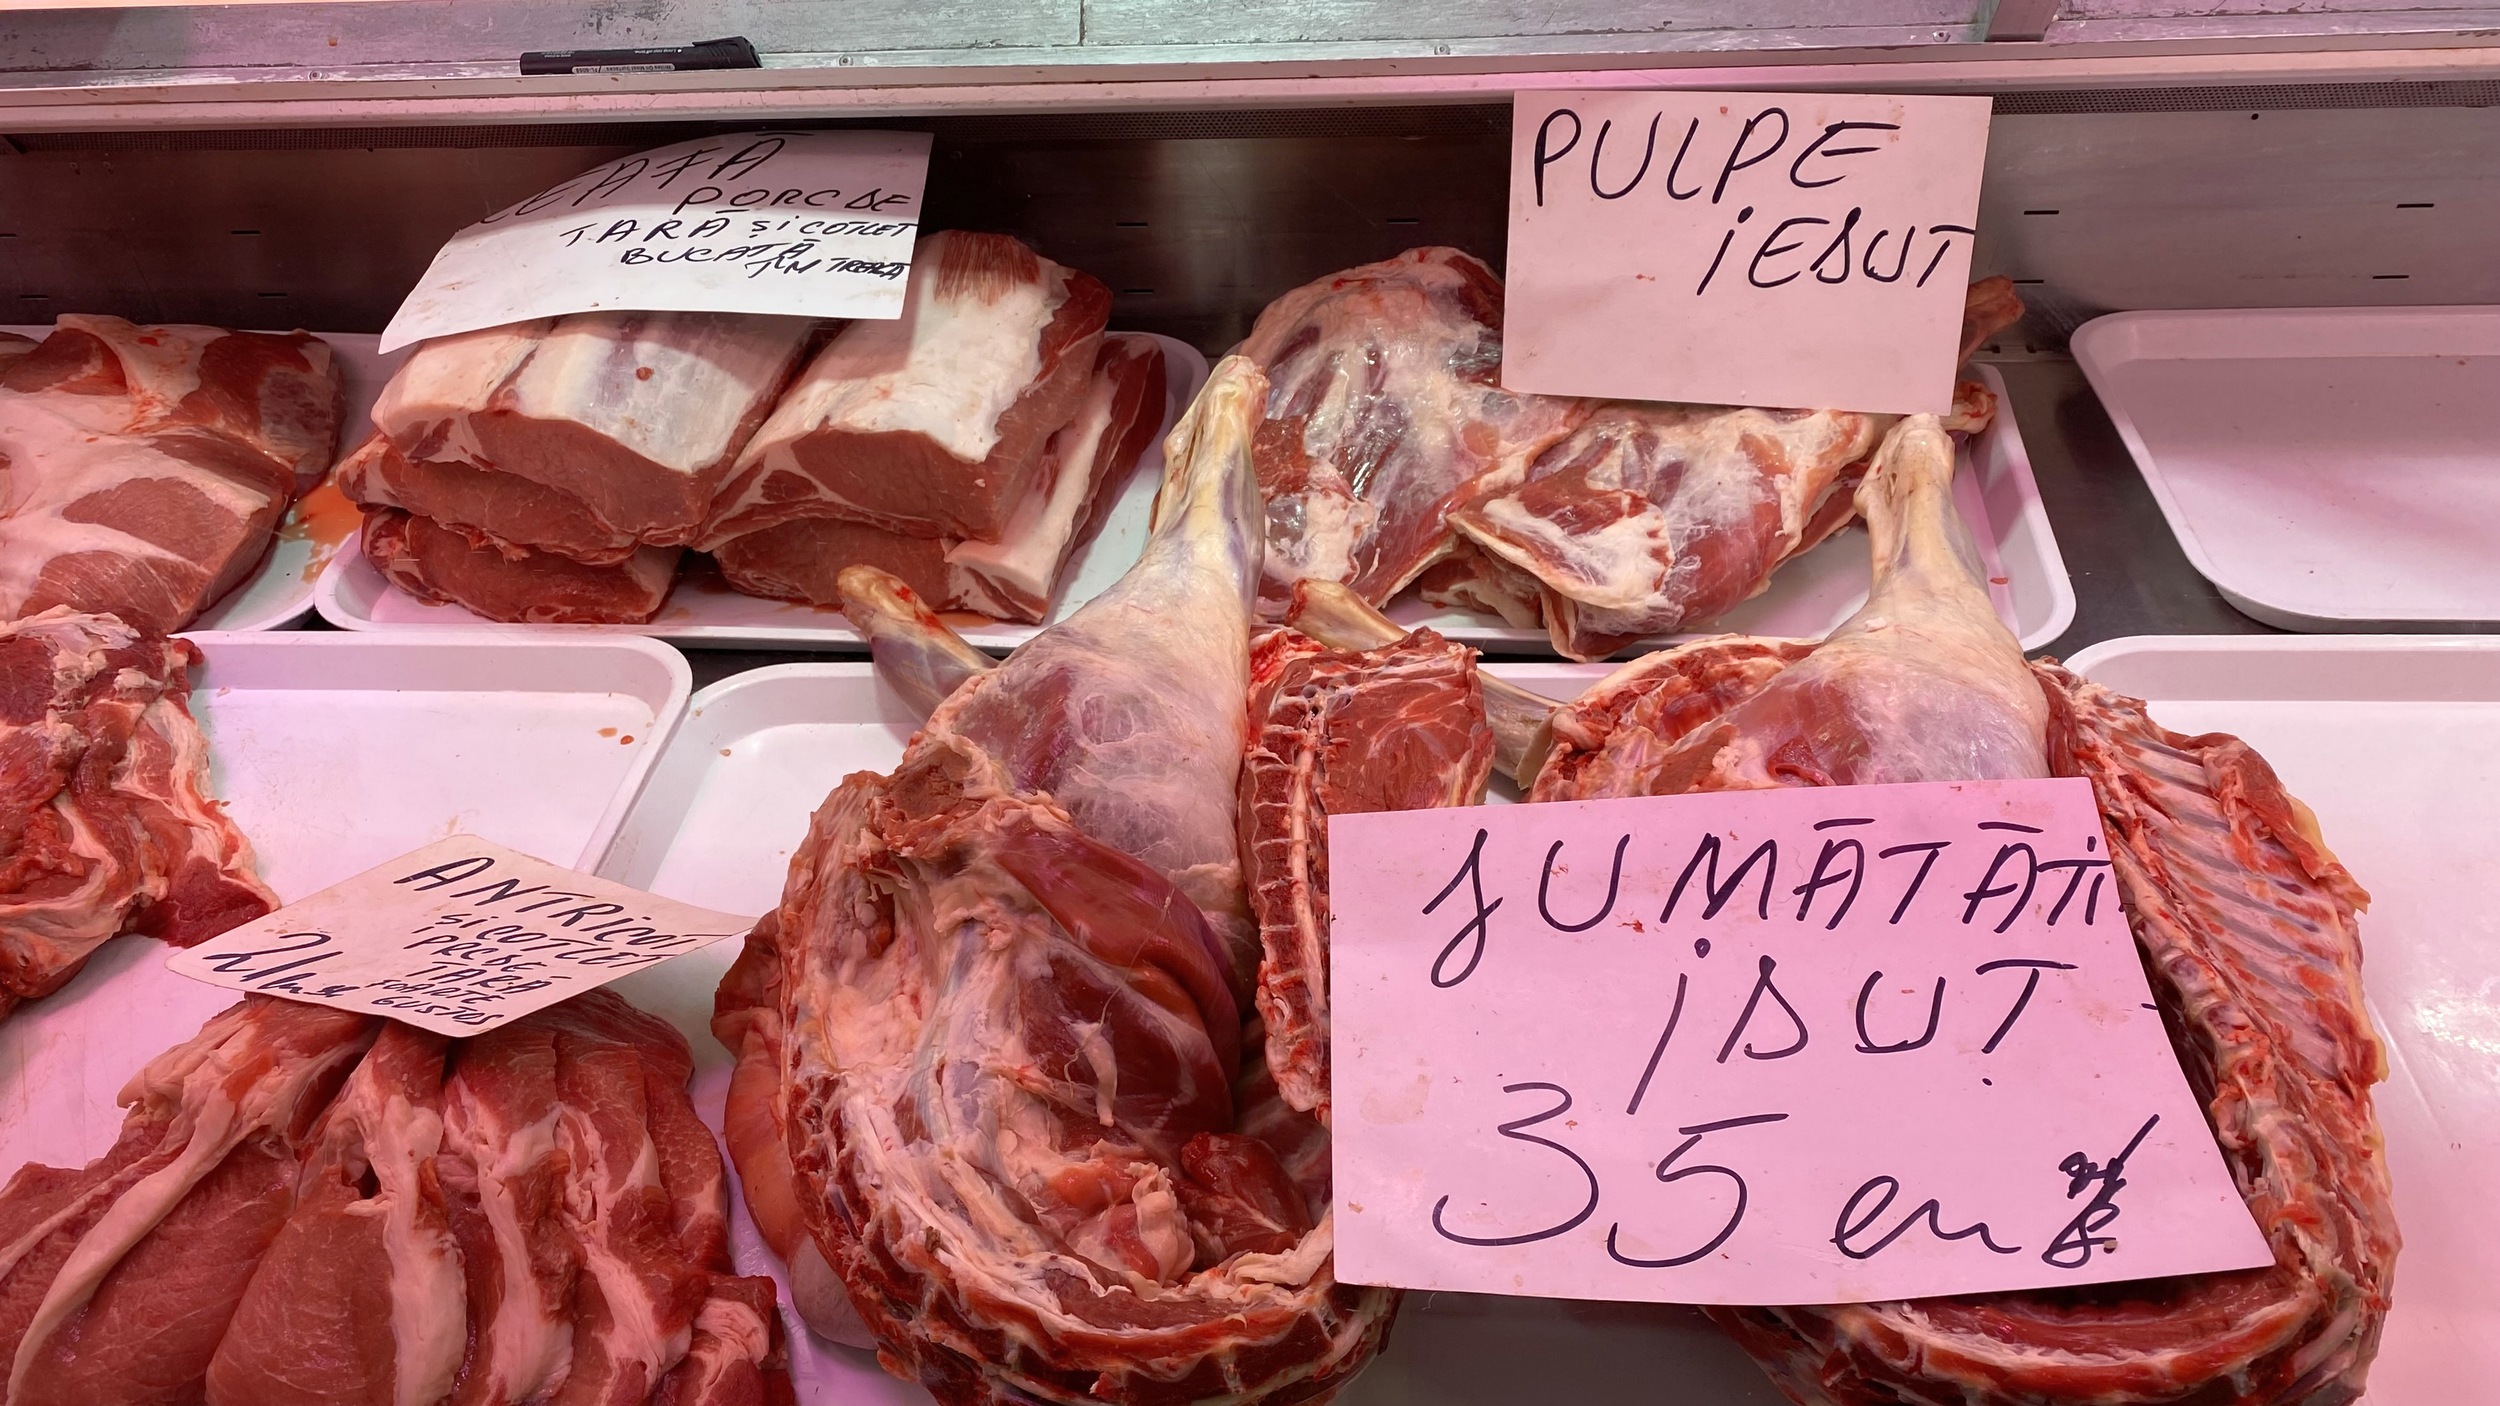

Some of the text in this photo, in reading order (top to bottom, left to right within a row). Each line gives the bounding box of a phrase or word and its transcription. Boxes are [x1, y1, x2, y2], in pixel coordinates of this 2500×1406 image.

[1534, 107, 1900, 207] PULPE
[673, 186, 841, 215] PORC
[371, 996, 504, 1025] GUSTOS
[1431, 1082, 1789, 1268] 35
